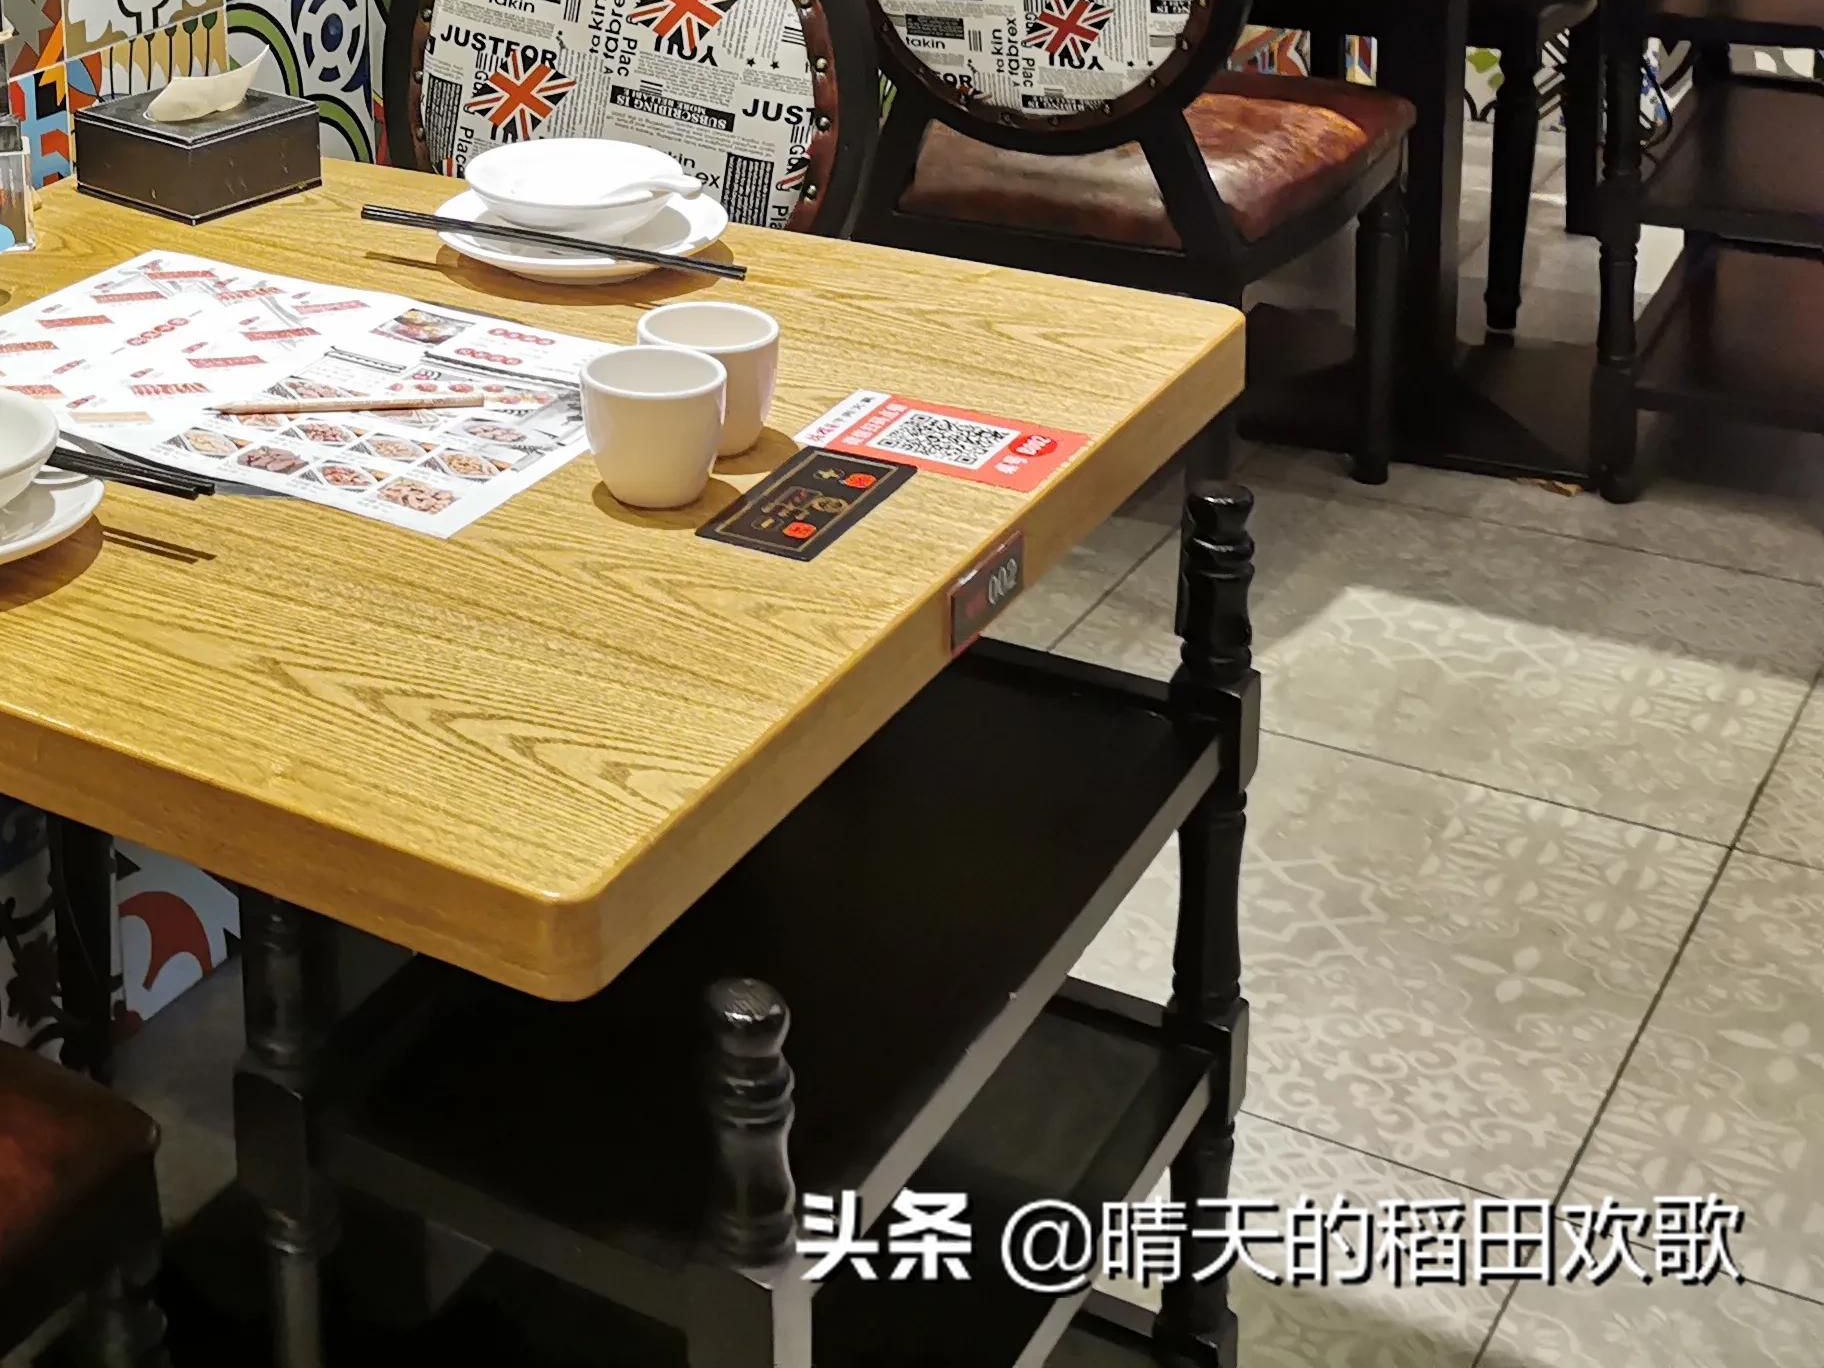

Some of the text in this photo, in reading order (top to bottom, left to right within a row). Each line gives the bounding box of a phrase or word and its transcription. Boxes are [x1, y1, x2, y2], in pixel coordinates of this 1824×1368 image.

[440, 24, 558, 69] JUSTFOR
[905, 36, 946, 50] takin
[632, 97, 727, 130] SUBSCRIBING
